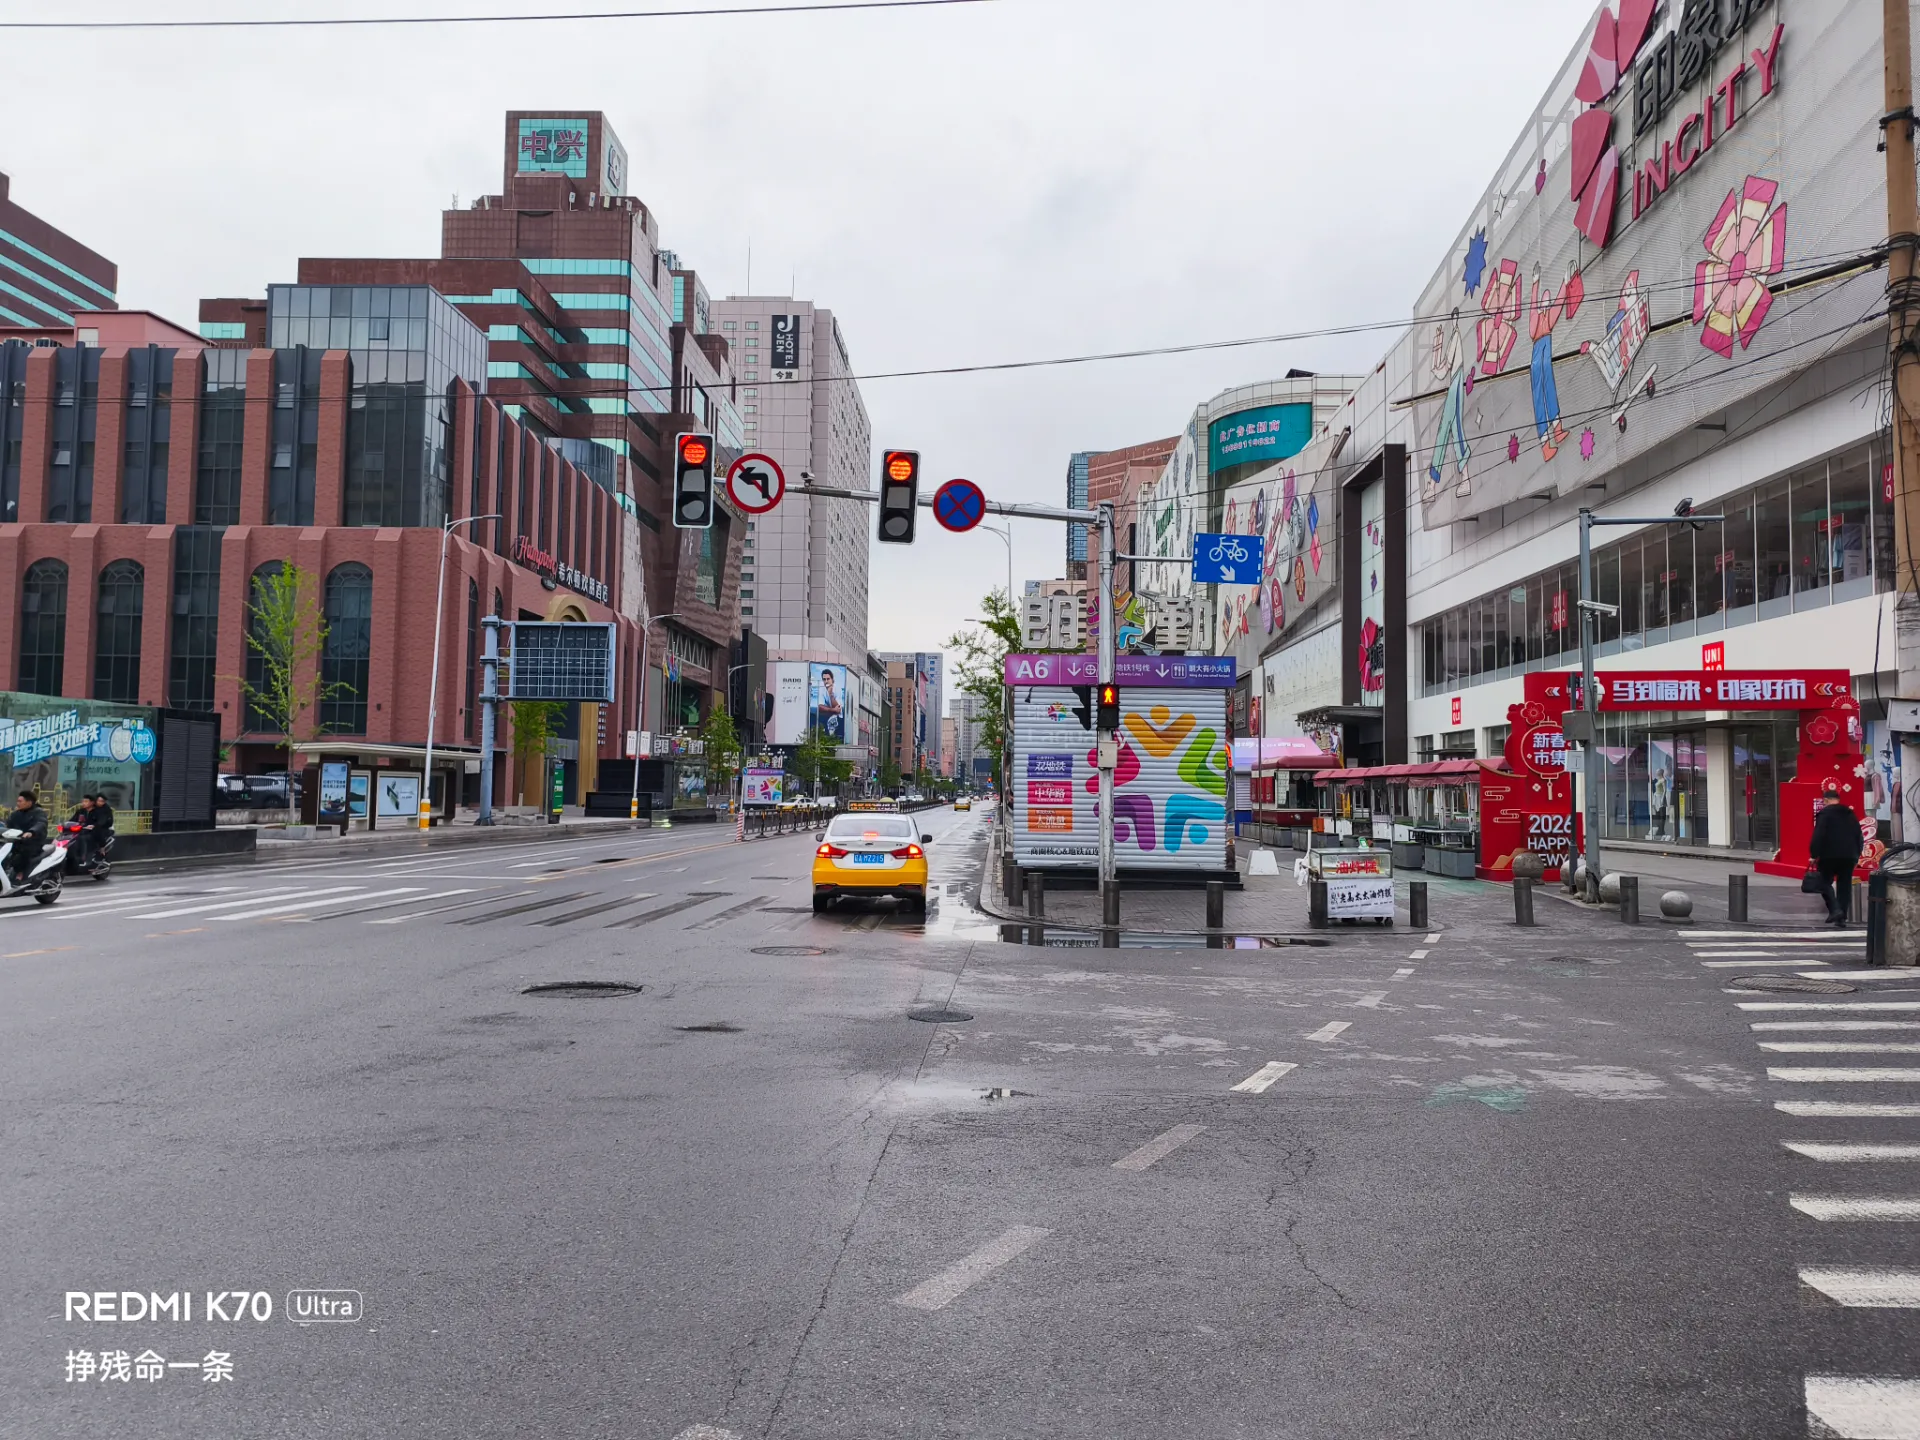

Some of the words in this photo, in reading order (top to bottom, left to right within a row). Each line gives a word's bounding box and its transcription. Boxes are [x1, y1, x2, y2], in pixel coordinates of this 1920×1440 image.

[1632, 23, 1785, 220] INCITY
[521, 130, 585, 160] 中兴
[776, 334, 785, 353] JEN
[785, 334, 794, 366] HOTEL
[516, 535, 558, 576] Hampton
[558, 561, 609, 602] 希尔顿欢朋酒店
[1705, 647, 1722, 664] UNI
[1016, 660, 1049, 680] A6
[1115, 664, 1151, 672] 地铁1号线
[1612, 678, 1807, 702] 马到福来·印象好市
[1532, 732, 1566, 748] 新春
[1034, 761, 1067, 772] 双地铁
[1533, 749, 1567, 766] 市集
[1034, 788, 1066, 799] 中华路
[1529, 814, 1572, 834] 2026
